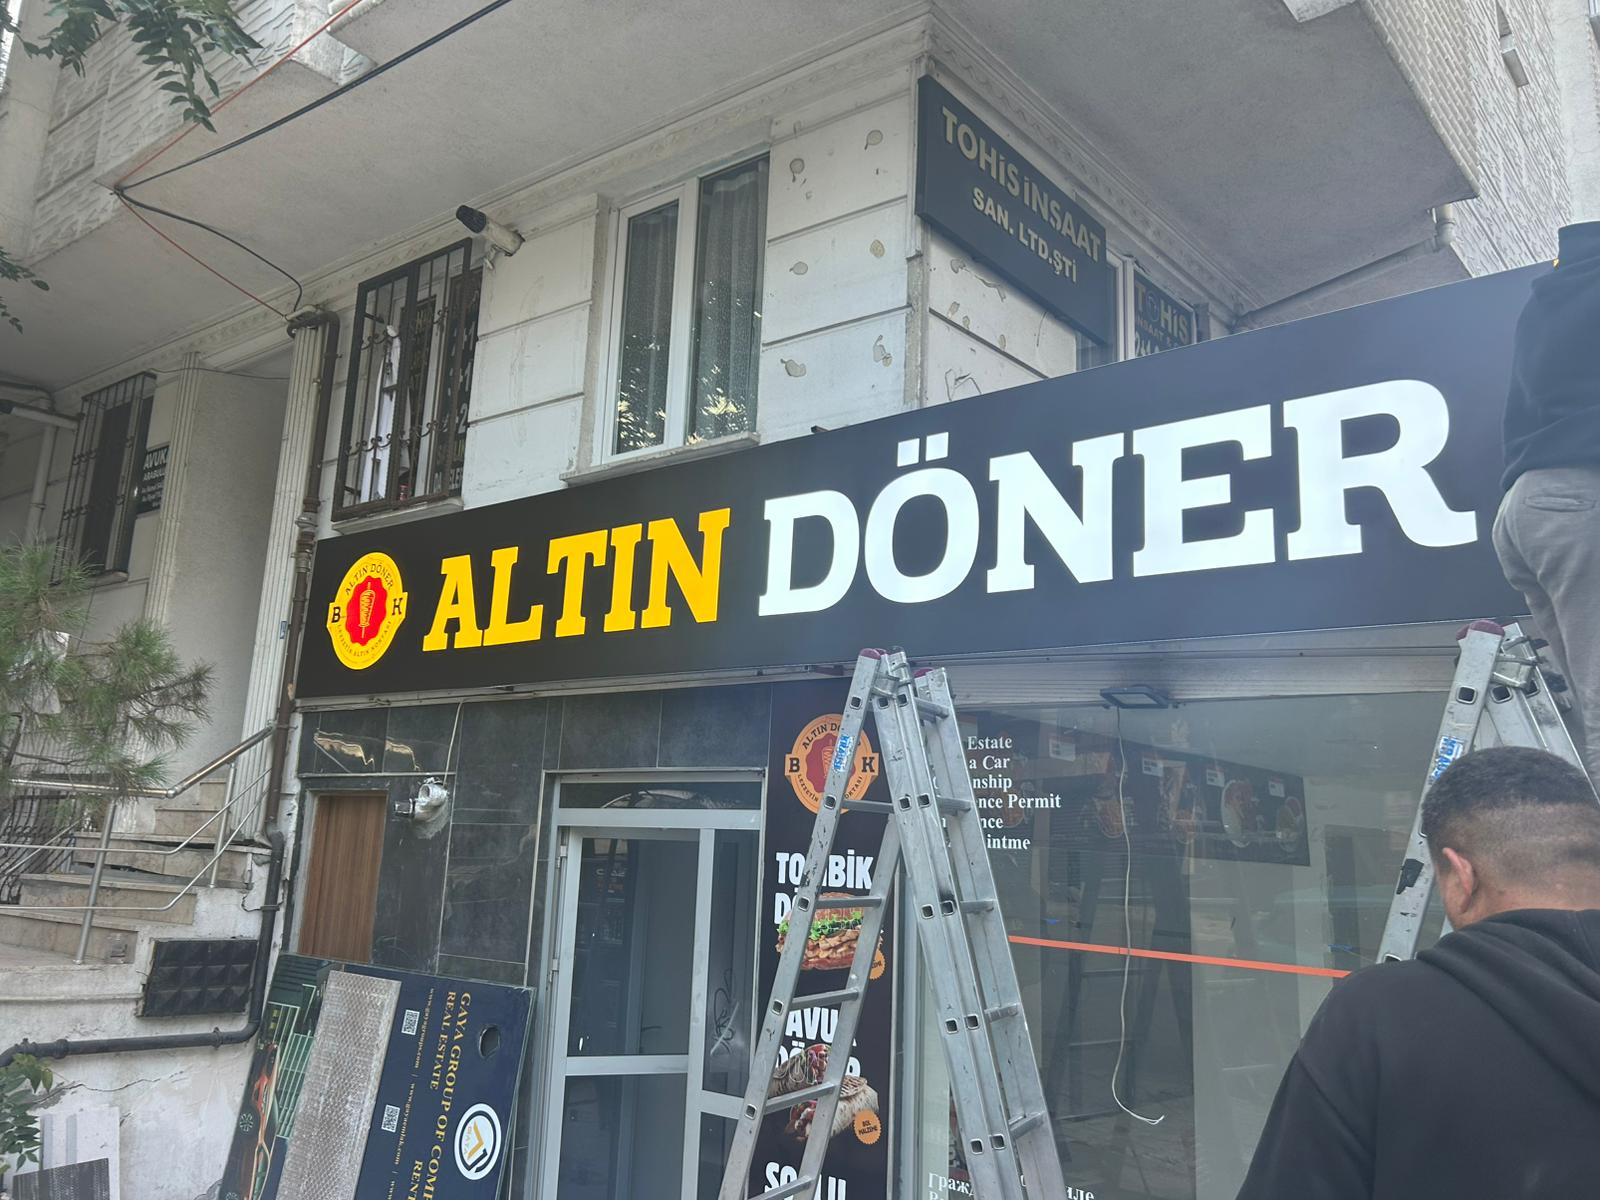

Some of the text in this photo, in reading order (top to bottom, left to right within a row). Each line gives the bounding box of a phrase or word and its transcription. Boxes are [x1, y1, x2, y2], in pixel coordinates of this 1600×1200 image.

[973, 186, 1014, 235] SAN.
[422, 379, 1478, 652] ALTIN DÖNER
[331, 606, 341, 623] B
[802, 723, 828, 750] ALTIN
[967, 735, 1013, 750] Estate
[789, 757, 800, 772] B
[861, 757, 875, 773] K
[969, 755, 1010, 770] a Car
[973, 774, 1013, 793] nship
[976, 793, 1062, 809] nce Permit
[980, 817, 1004, 829] nce
[987, 834, 1031, 850] intme
[775, 849, 874, 889] TOBİK
[454, 992, 471, 1040] GAYA
[785, 1007, 857, 1047] AVU
[430, 991, 457, 1090] REAL ESTATE
[442, 1045, 462, 1112] GROUP
[435, 1114, 448, 1142] OF
